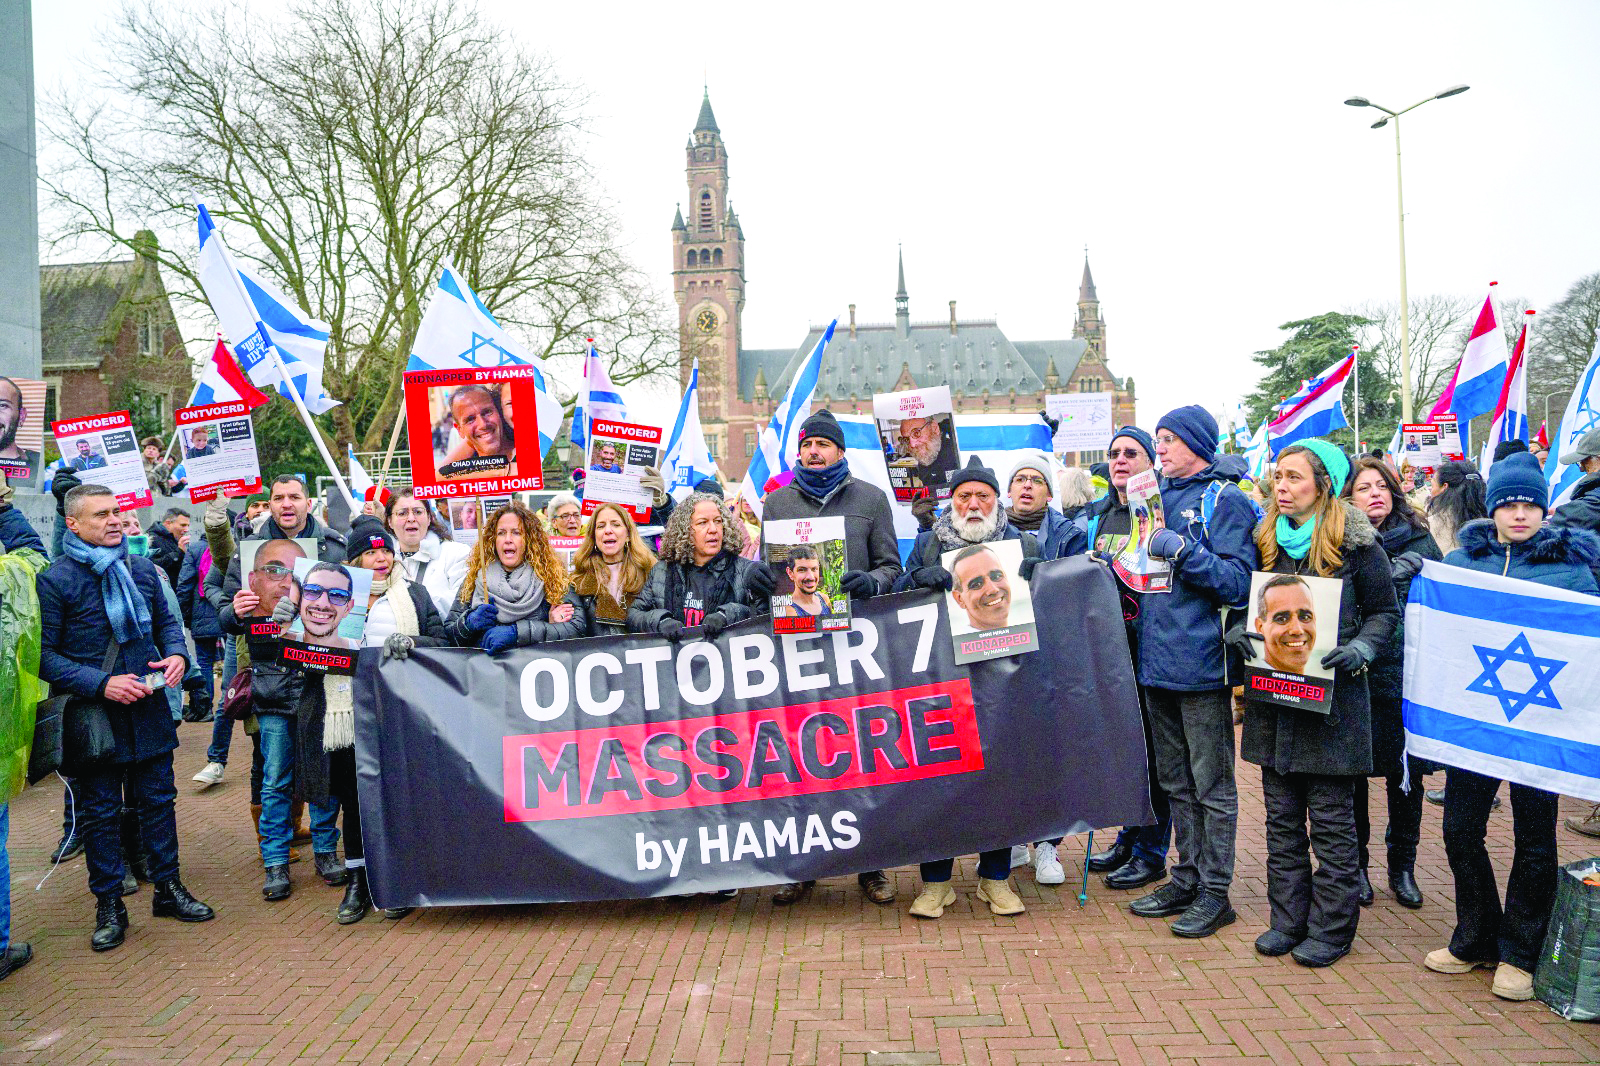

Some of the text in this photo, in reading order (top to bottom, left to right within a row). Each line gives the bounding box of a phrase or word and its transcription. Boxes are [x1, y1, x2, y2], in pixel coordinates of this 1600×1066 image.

[405, 368, 534, 384] KIDNAPPED BY HAMAS
[181, 404, 244, 420] ONTVOERD
[58, 415, 125, 433] ONTVOERD
[597, 424, 657, 439] ONTVOERD
[472, 458, 505, 466] YAHALOMI
[414, 477, 540, 497] BRING THEM HOME
[771, 595, 792, 606] BRING
[774, 617, 793, 629] HOME
[794, 616, 815, 629] NOW!
[964, 634, 1028, 652] KIDNAPPED
[287, 648, 349, 666] KIDNAPPED
[519, 603, 940, 722] OCTOBER 7
[1287, 674, 1305, 682] MIRAN
[1255, 677, 1321, 699] KIDNAPPED
[1280, 694, 1300, 702] HAMAS
[520, 694, 962, 810] MASSACRE
[635, 810, 861, 877] by HAMAS
